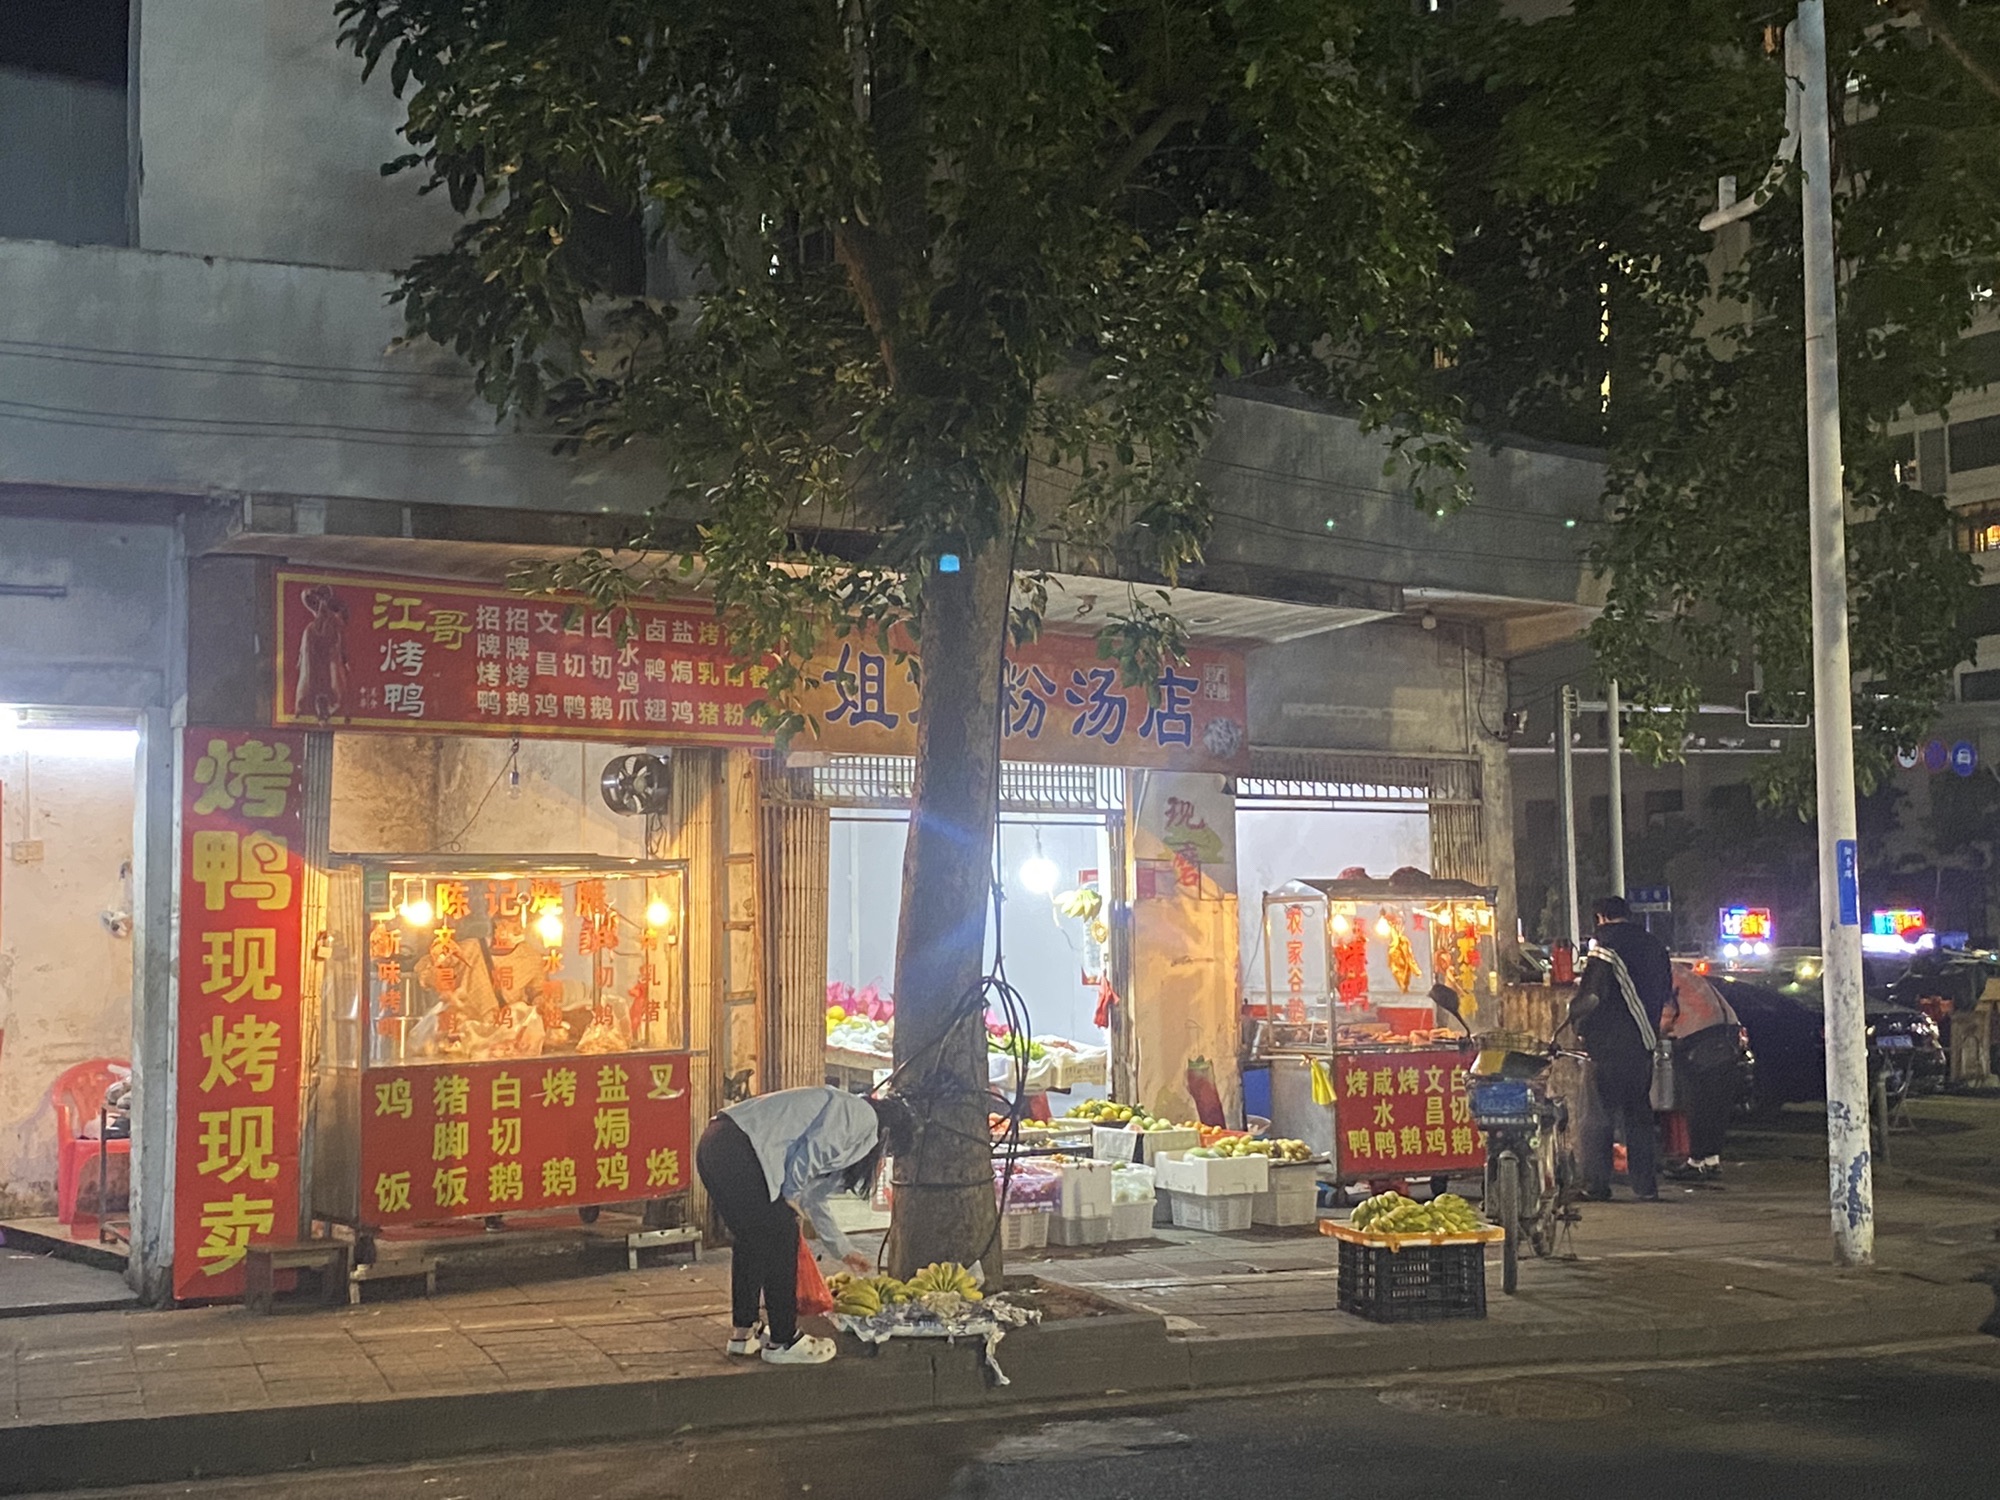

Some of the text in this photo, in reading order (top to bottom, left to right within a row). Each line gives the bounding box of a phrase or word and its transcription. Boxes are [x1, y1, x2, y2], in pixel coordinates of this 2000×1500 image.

[372, 592, 473, 650] 江哥
[476, 605, 501, 716] 招牌烤鸭
[505, 606, 530, 717] 招牌烤鹅
[535, 610, 558, 718] 文昌鸡
[644, 618, 667, 723] 卤鸭翅
[671, 620, 694, 724] 盐焗鸡
[698, 621, 720, 726] 烤乳猪
[380, 638, 427, 718] 烤鸭
[823, 642, 1201, 748] 姐粉汤店
[190, 739, 294, 1277] 烤鸭现烤现卖
[374, 1078, 414, 1214] 鸡饭
[432, 1072, 470, 1209] 猪脚饭
[487, 1070, 525, 1205] 白切鹅
[540, 1066, 577, 1198] 烤鹅
[593, 1064, 630, 1193] 盐焗鸡
[645, 1064, 685, 1188] 叉烧
[1345, 1068, 1371, 1159] 烤鸭
[1372, 1066, 1398, 1160] 咸水鸭
[1397, 1066, 1422, 1155] 烤鹅
[1424, 1064, 1447, 1157] 文昌鸡
[1449, 1064, 1474, 1155] 白切鹅
